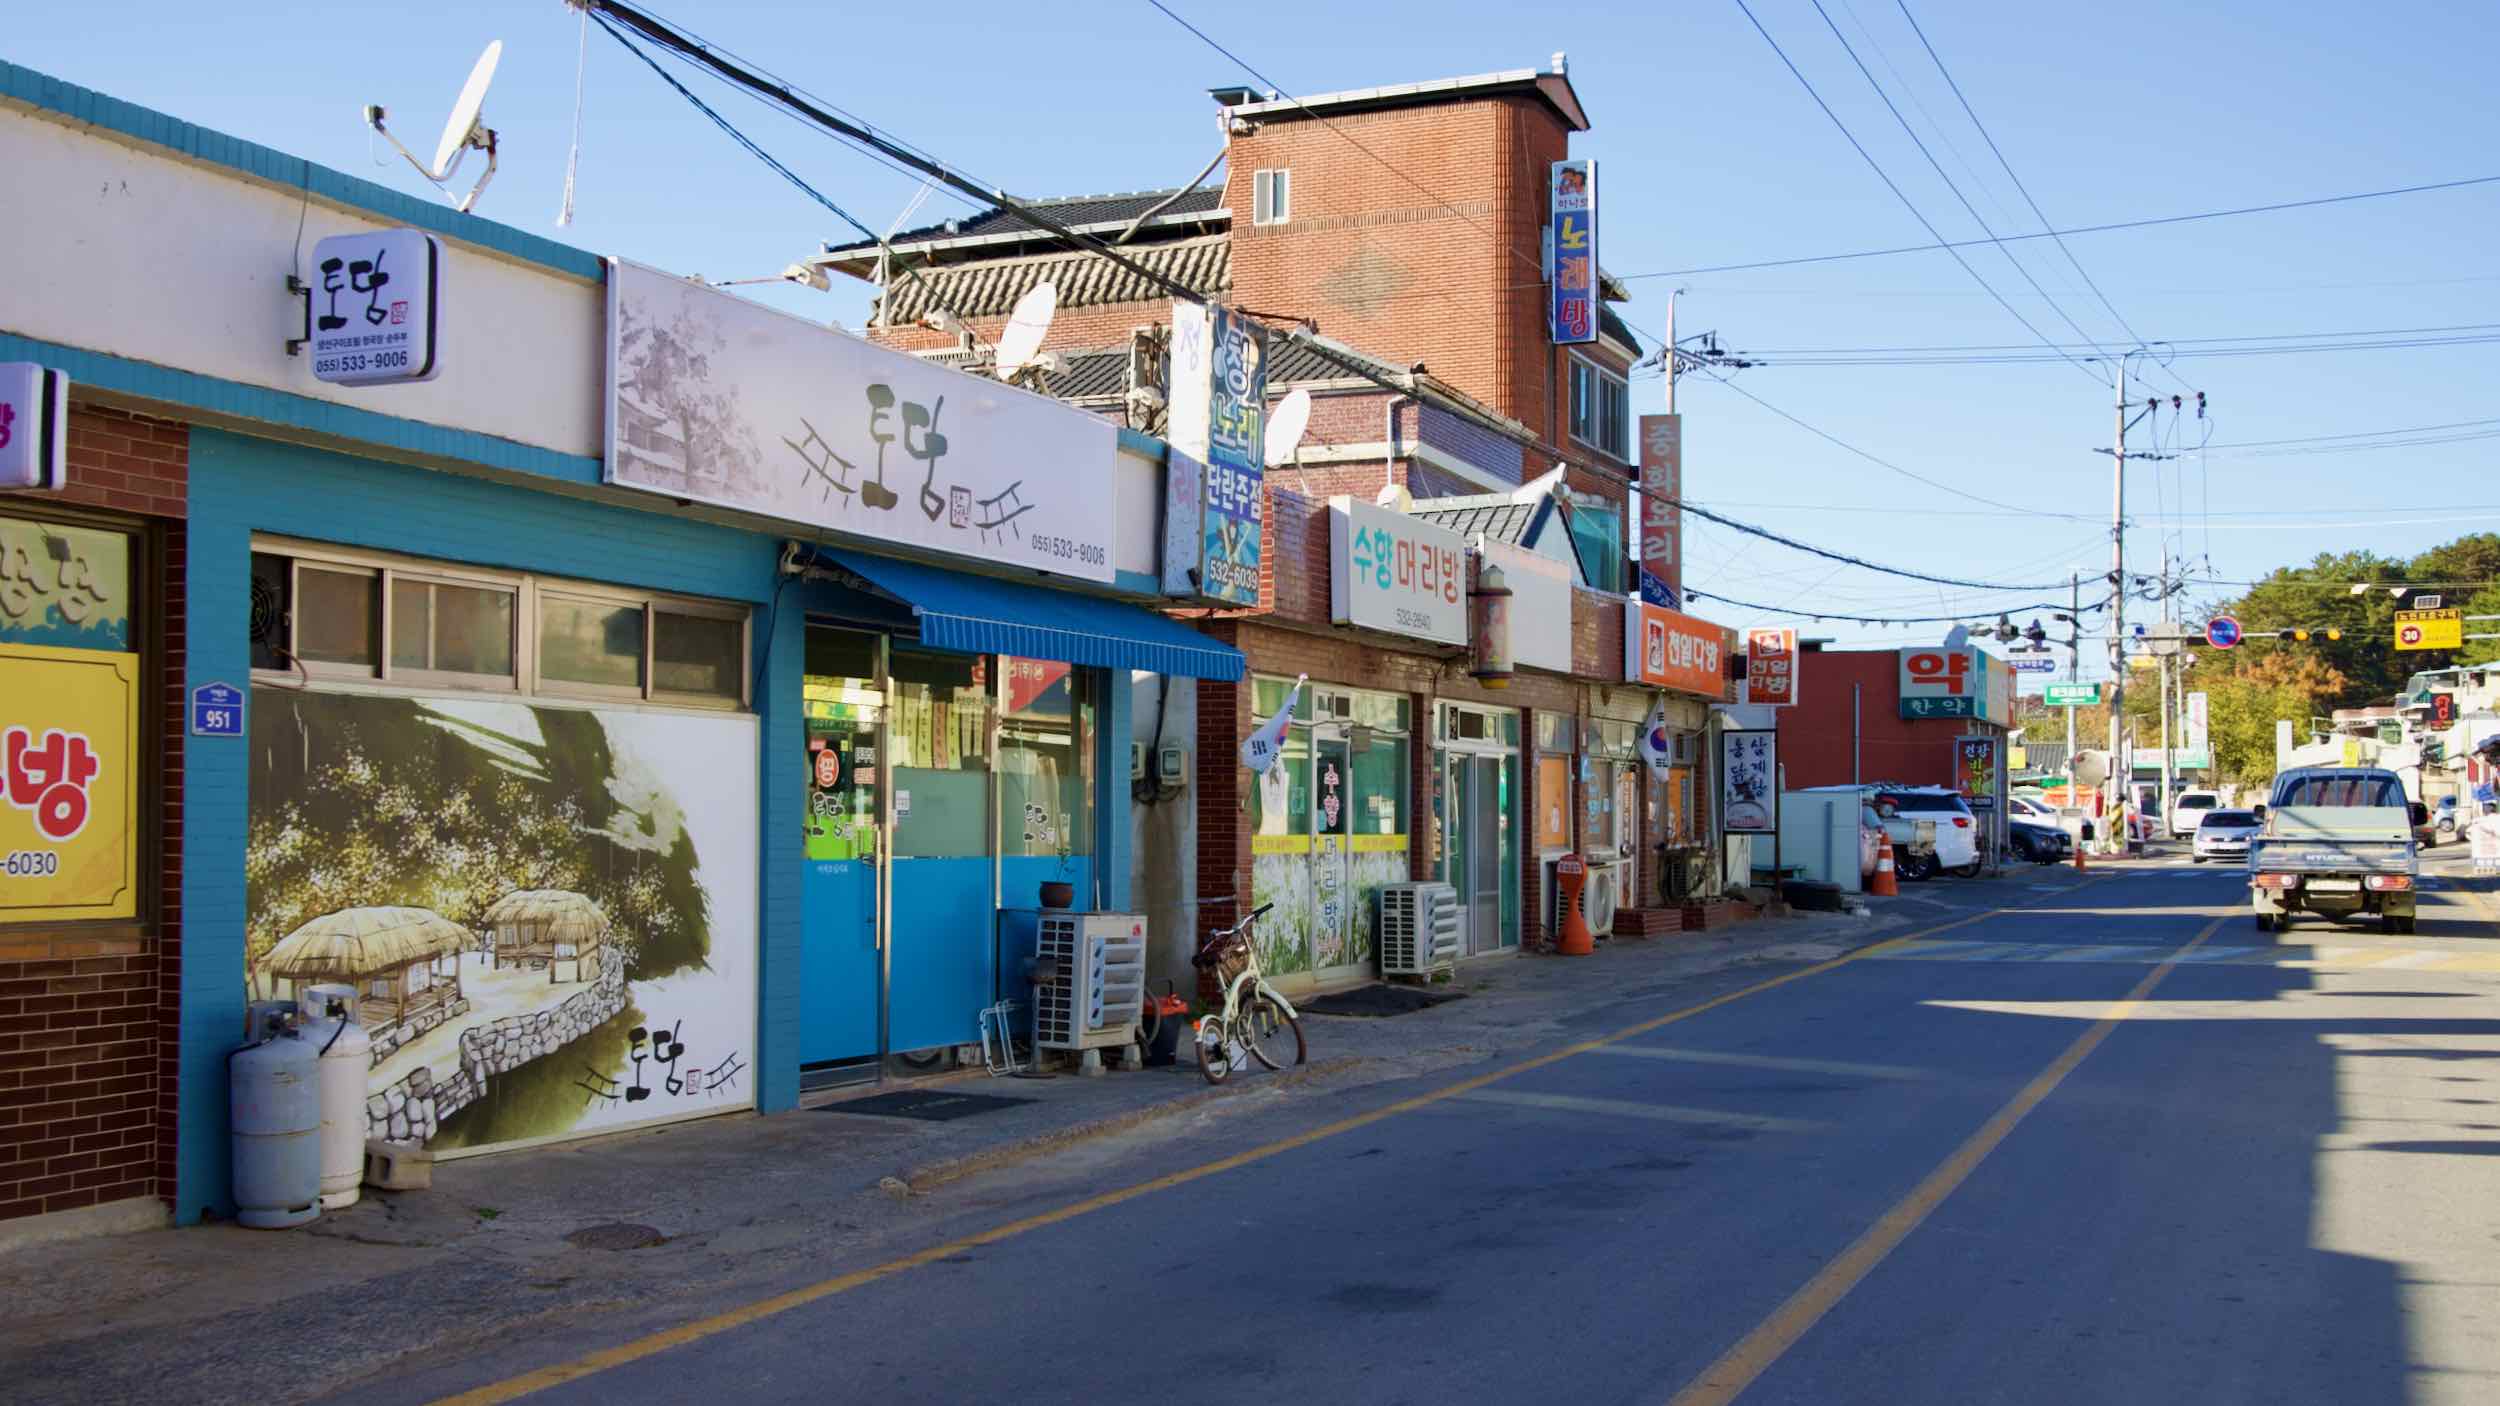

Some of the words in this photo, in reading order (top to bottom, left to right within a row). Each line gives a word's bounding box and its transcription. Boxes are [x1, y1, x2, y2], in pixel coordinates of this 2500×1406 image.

[318, 248, 389, 331] 토담
[1560, 216, 1589, 338] 노래방
[861, 384, 948, 522] 토담
[1212, 393, 1261, 469] 노래
[1208, 464, 1263, 520] 단란주점
[1210, 559, 1258, 590] 532-6039
[2404, 630, 2418, 641] 30
[1907, 653, 1969, 695] 약
[206, 710, 230, 729] 951
[0, 730, 98, 838] 방
[625, 1019, 685, 1103] 토담
